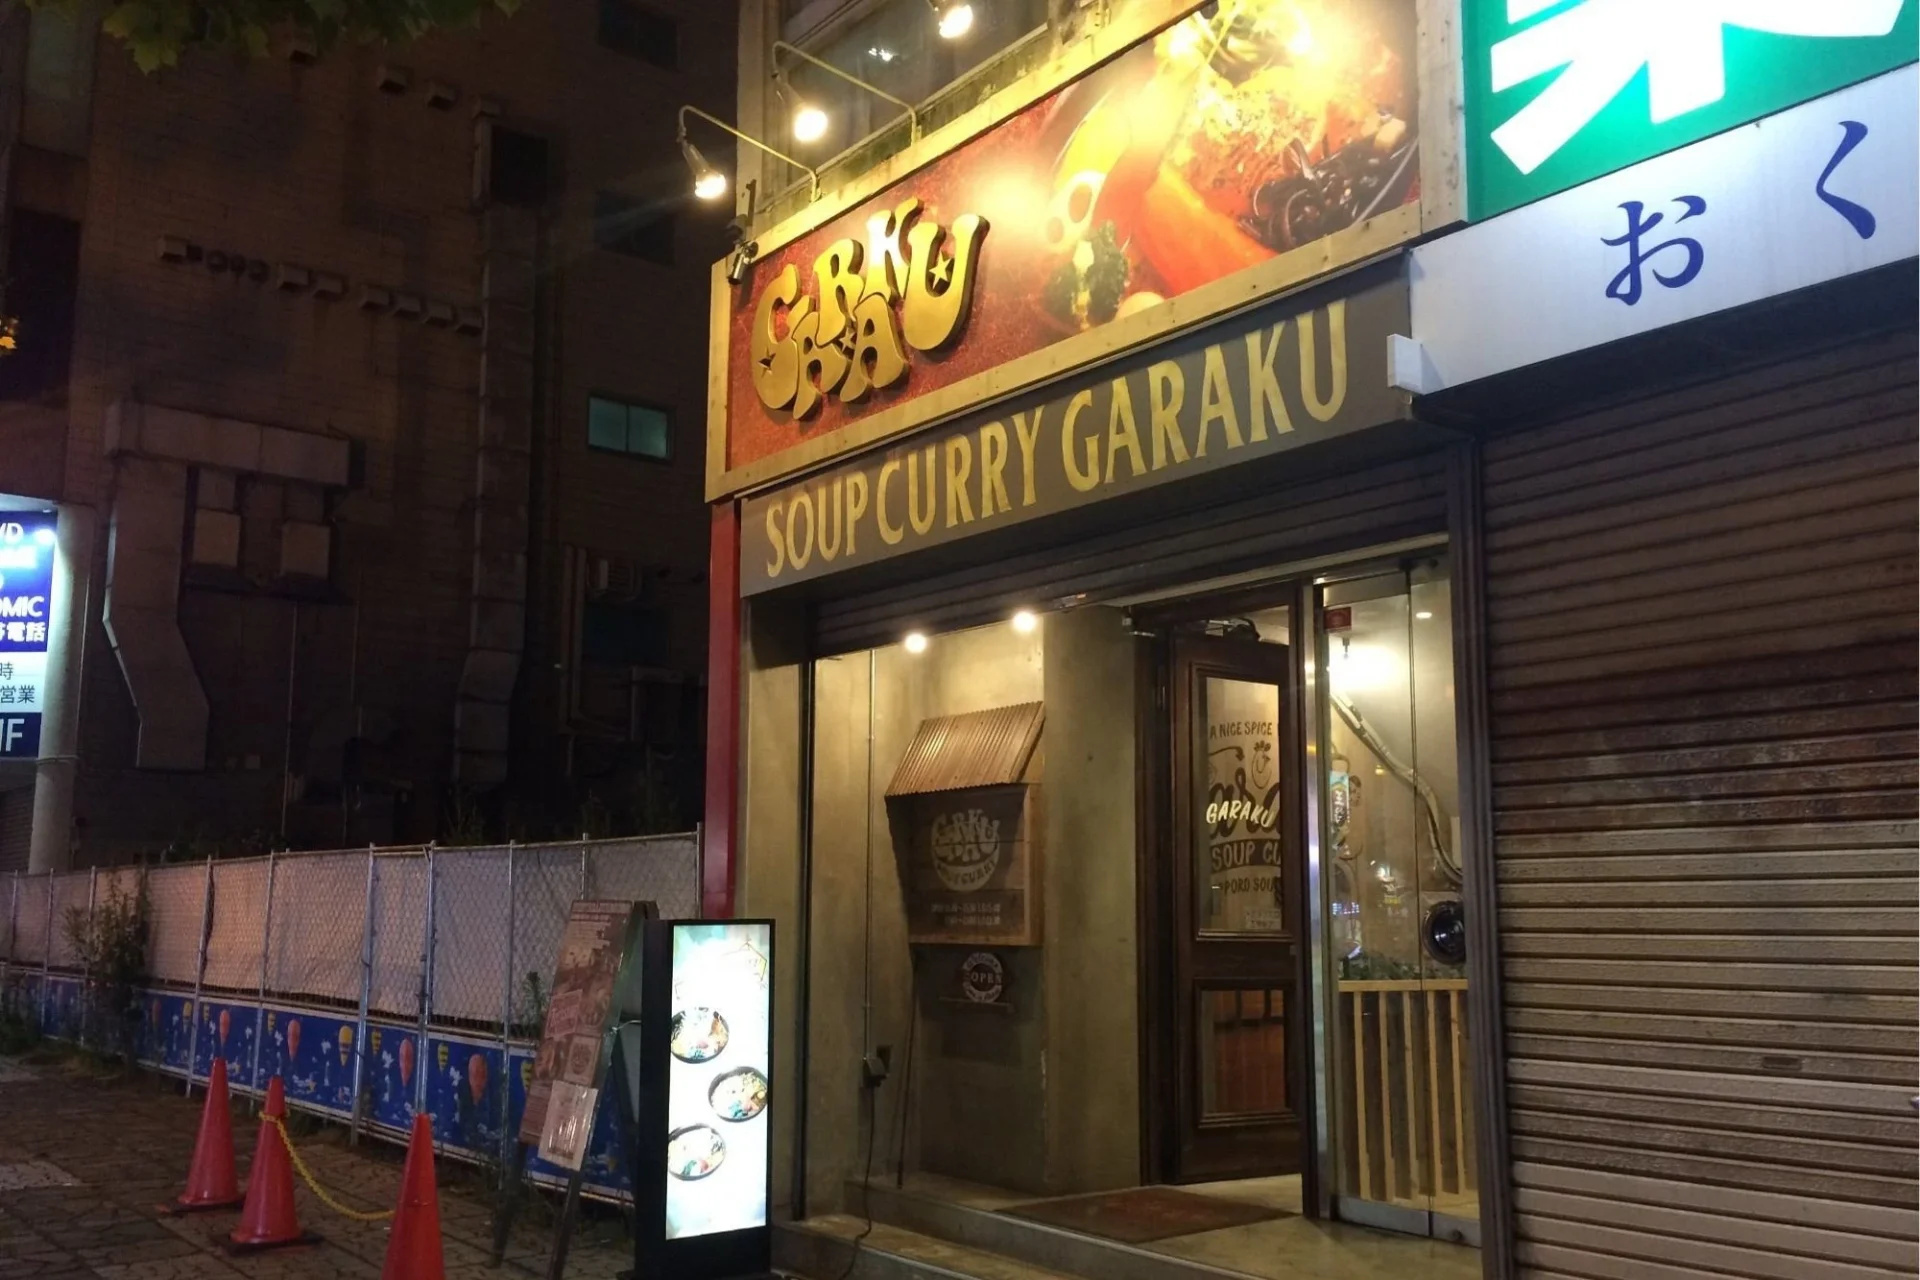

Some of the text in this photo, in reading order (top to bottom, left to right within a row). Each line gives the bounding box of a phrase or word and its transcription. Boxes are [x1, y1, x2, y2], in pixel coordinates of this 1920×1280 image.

[1601, 121, 1876, 306] おく
[751, 196, 988, 420] GARAKU
[766, 299, 1348, 577] SOUP CURRY GARAKU
[0, 684, 35, 704] 営業
[1210, 721, 1273, 740] A NICE SPICE
[1206, 799, 1276, 828] GARAKU
[1211, 843, 1256, 871] SOUP
[970, 971, 1003, 984] OPEN
